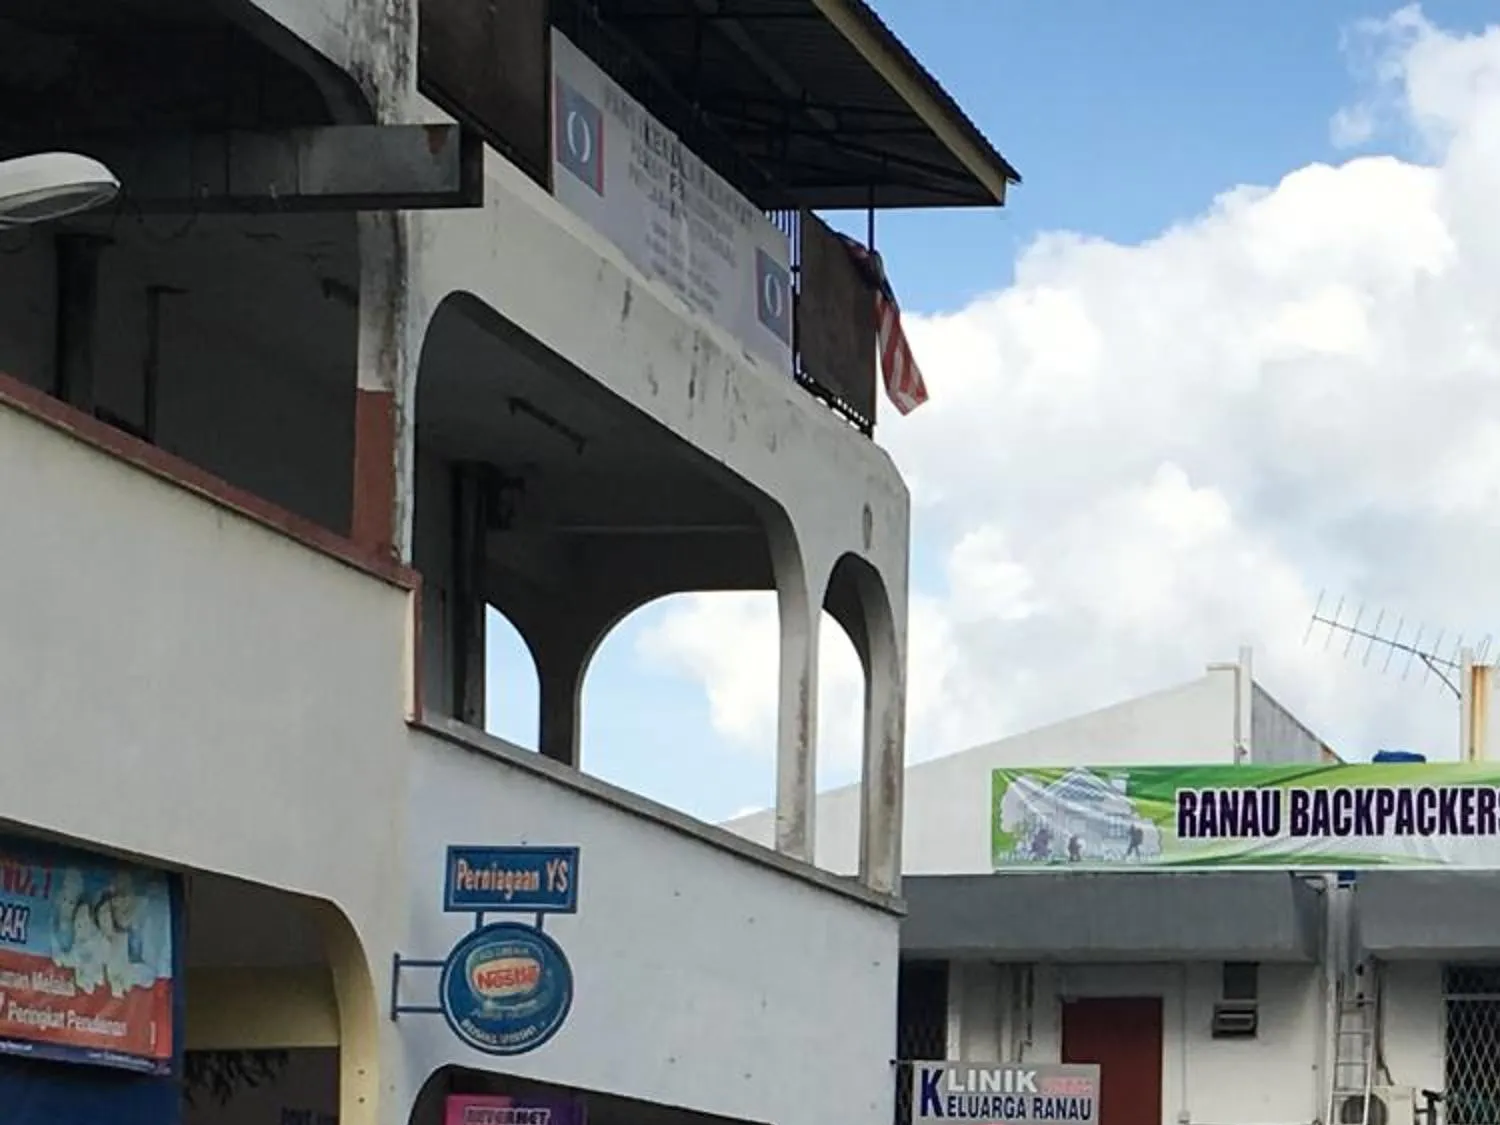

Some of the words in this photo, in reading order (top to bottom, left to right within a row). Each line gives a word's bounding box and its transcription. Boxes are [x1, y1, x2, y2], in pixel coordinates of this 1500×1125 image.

[1177, 788, 1282, 838] RANAU
[455, 858, 540, 901] Perniagaan
[545, 858, 569, 893] YS
[1033, 1095, 1092, 1121] RANAU
